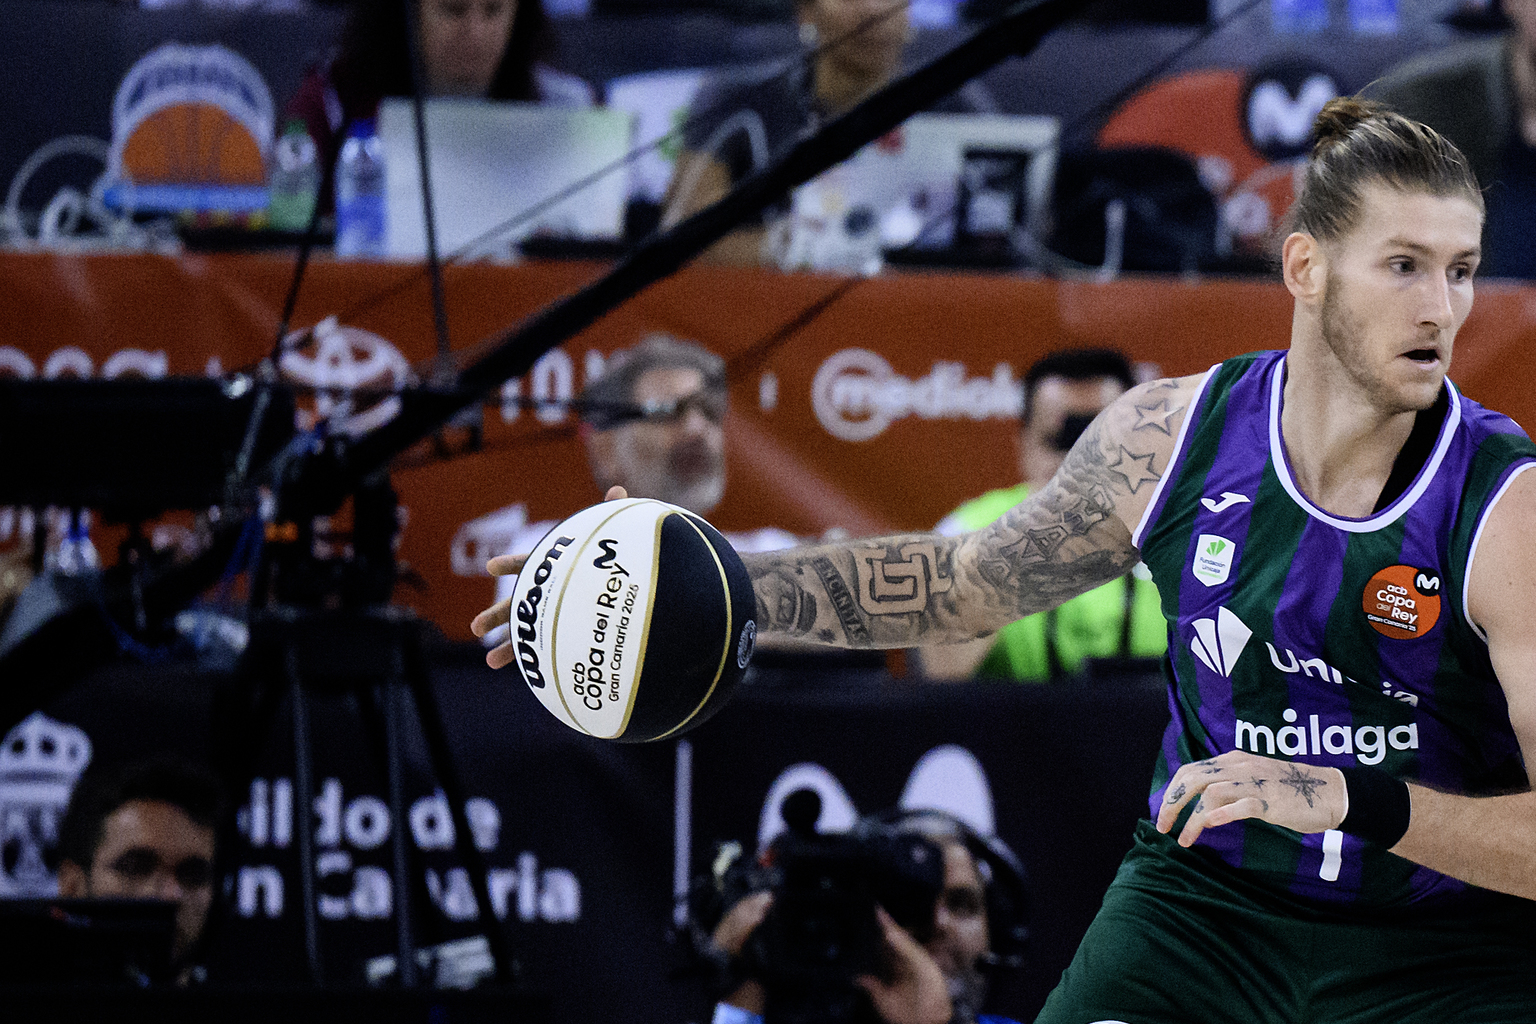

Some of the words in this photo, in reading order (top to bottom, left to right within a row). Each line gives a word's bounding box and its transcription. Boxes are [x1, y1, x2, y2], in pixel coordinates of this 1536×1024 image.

[597, 562, 630, 609] Rey
[1376, 589, 1416, 609] Copa
[1386, 584, 1408, 596] acb
[593, 613, 609, 643] del
[1391, 606, 1418, 625] Rey
[610, 616, 630, 671] Canaria
[572, 662, 585, 695] acb
[583, 648, 606, 711] Copa
[609, 673, 620, 702] Gran
[1234, 708, 1420, 766] málaga
